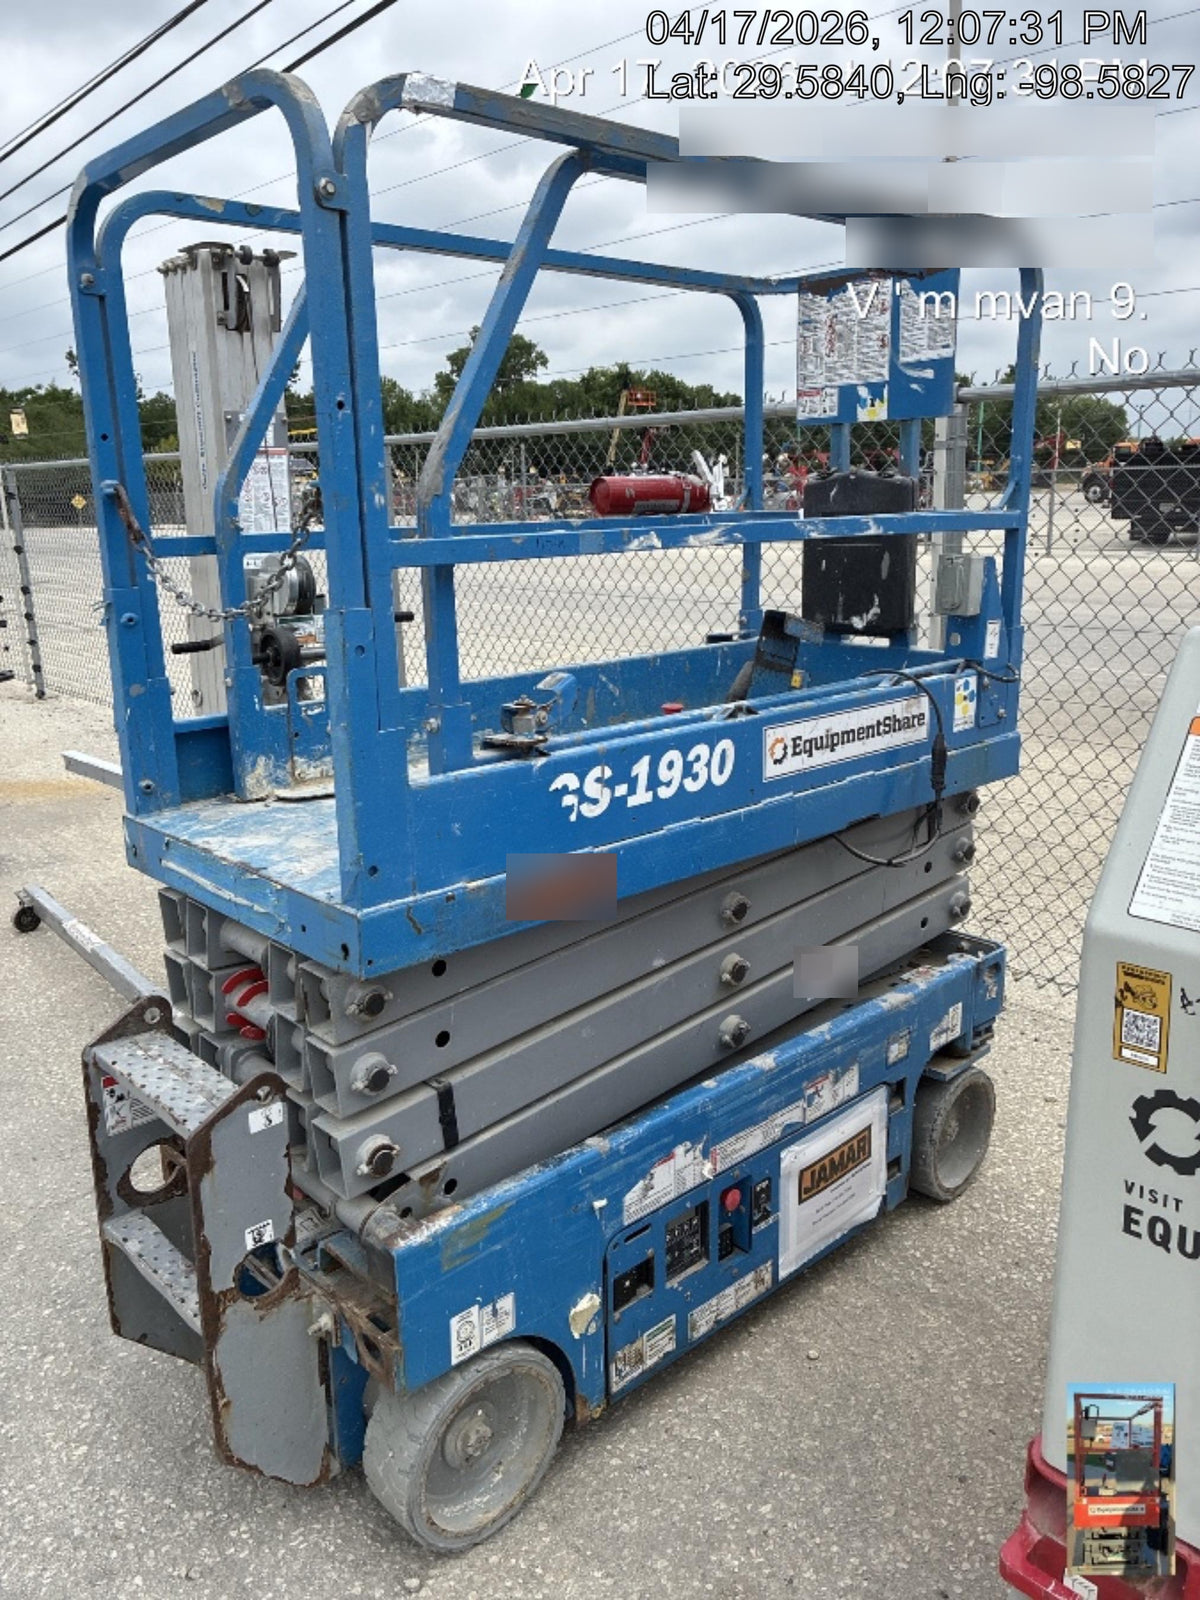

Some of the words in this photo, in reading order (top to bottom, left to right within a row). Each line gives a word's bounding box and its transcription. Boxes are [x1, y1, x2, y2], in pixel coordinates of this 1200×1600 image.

[791, 712, 926, 758] EquipmentShare
[803, 1134, 868, 1196] JAMAR
[1124, 1179, 1183, 1213] VISIT
[1122, 1204, 1200, 1260] EQU
